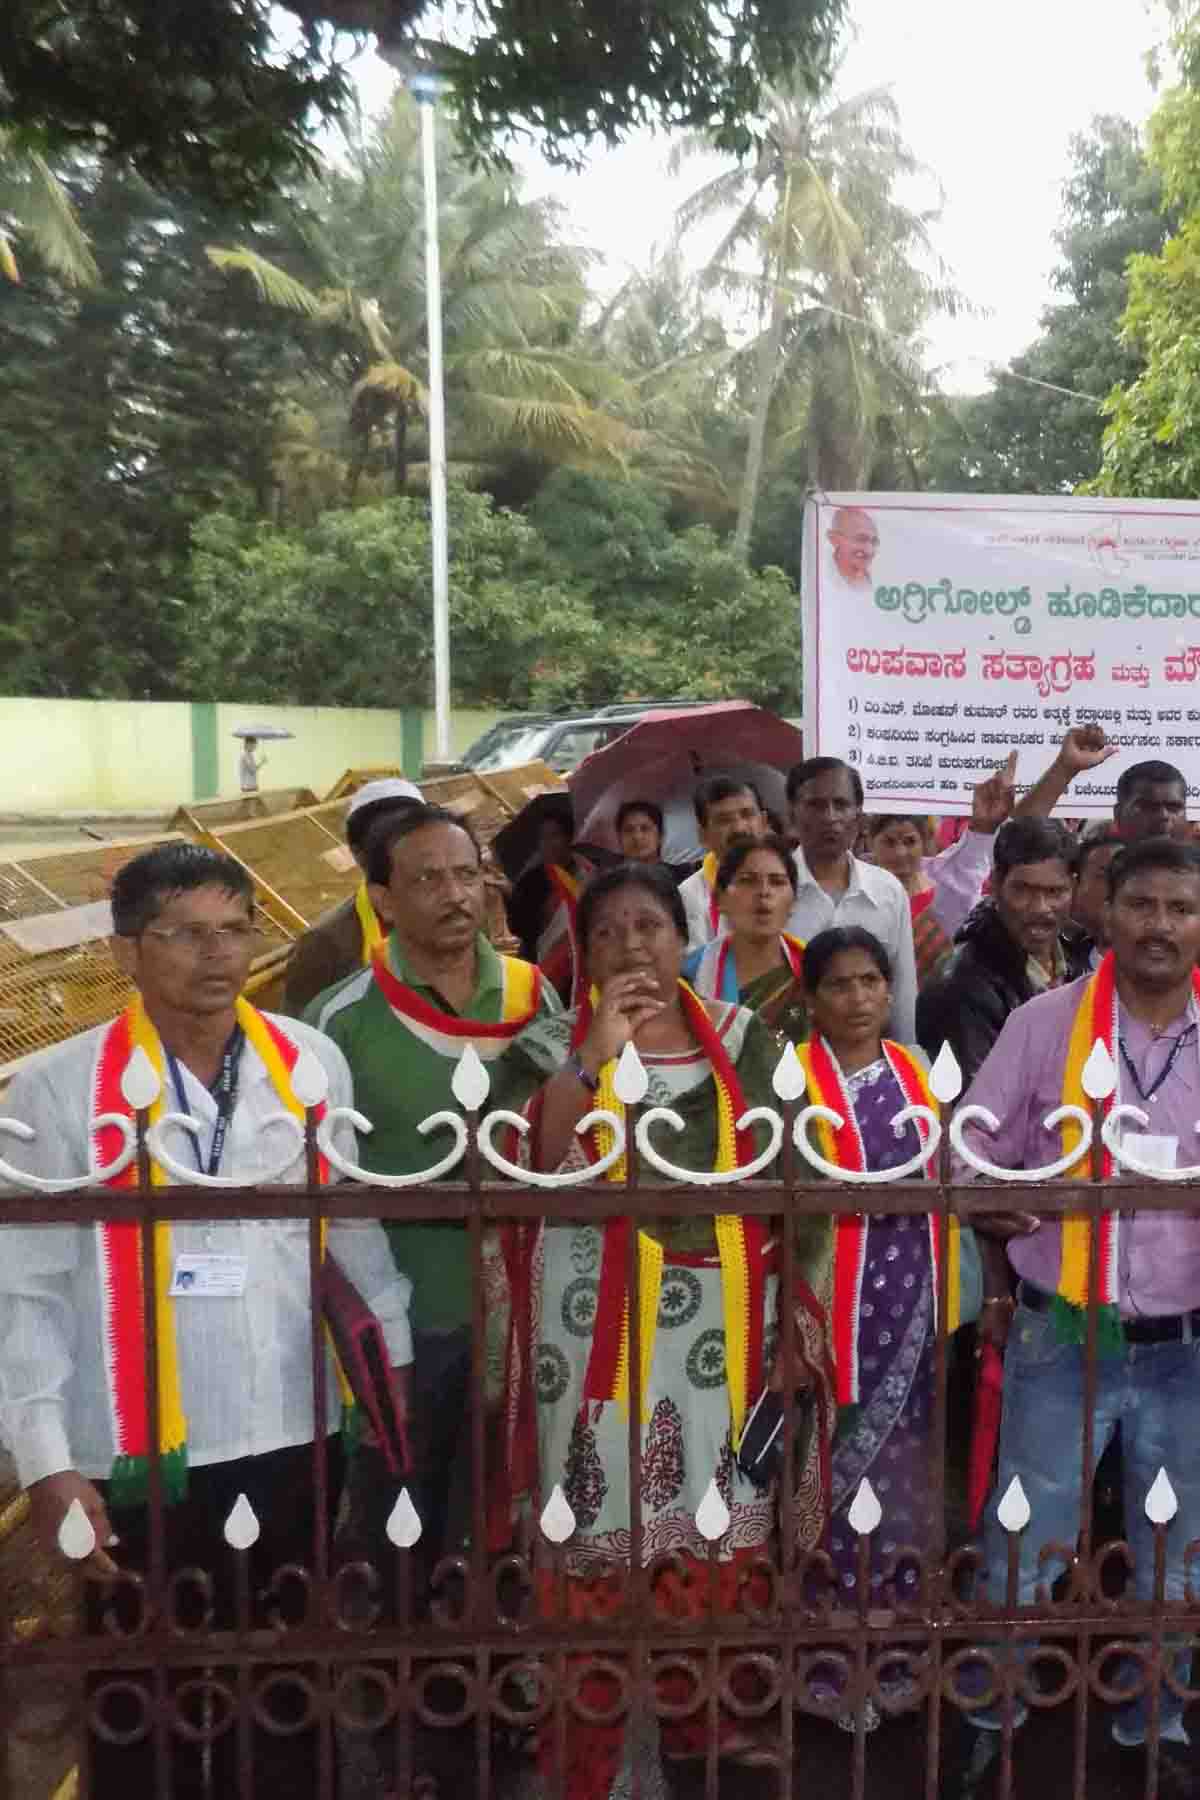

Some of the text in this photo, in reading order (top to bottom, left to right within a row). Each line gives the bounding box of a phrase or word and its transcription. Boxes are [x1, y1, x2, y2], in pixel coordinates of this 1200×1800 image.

[874, 577, 1032, 634] ಅಗ್ರಿಗೋಲ್ಡ್
[846, 645, 966, 679] ಉಪವಾಸ
[981, 647, 1096, 697] ಸತ್ಯಾಗ್ರಹ
[1112, 661, 1151, 688] ಮತ್ತು
[964, 704, 1008, 718] ಕುಮಾರ್
[1126, 706, 1152, 725] ಮತ್ತು
[848, 721, 861, 741] 2)
[866, 727, 919, 742] ಕಂಪನಿಯು
[848, 748, 862, 764] 3)
